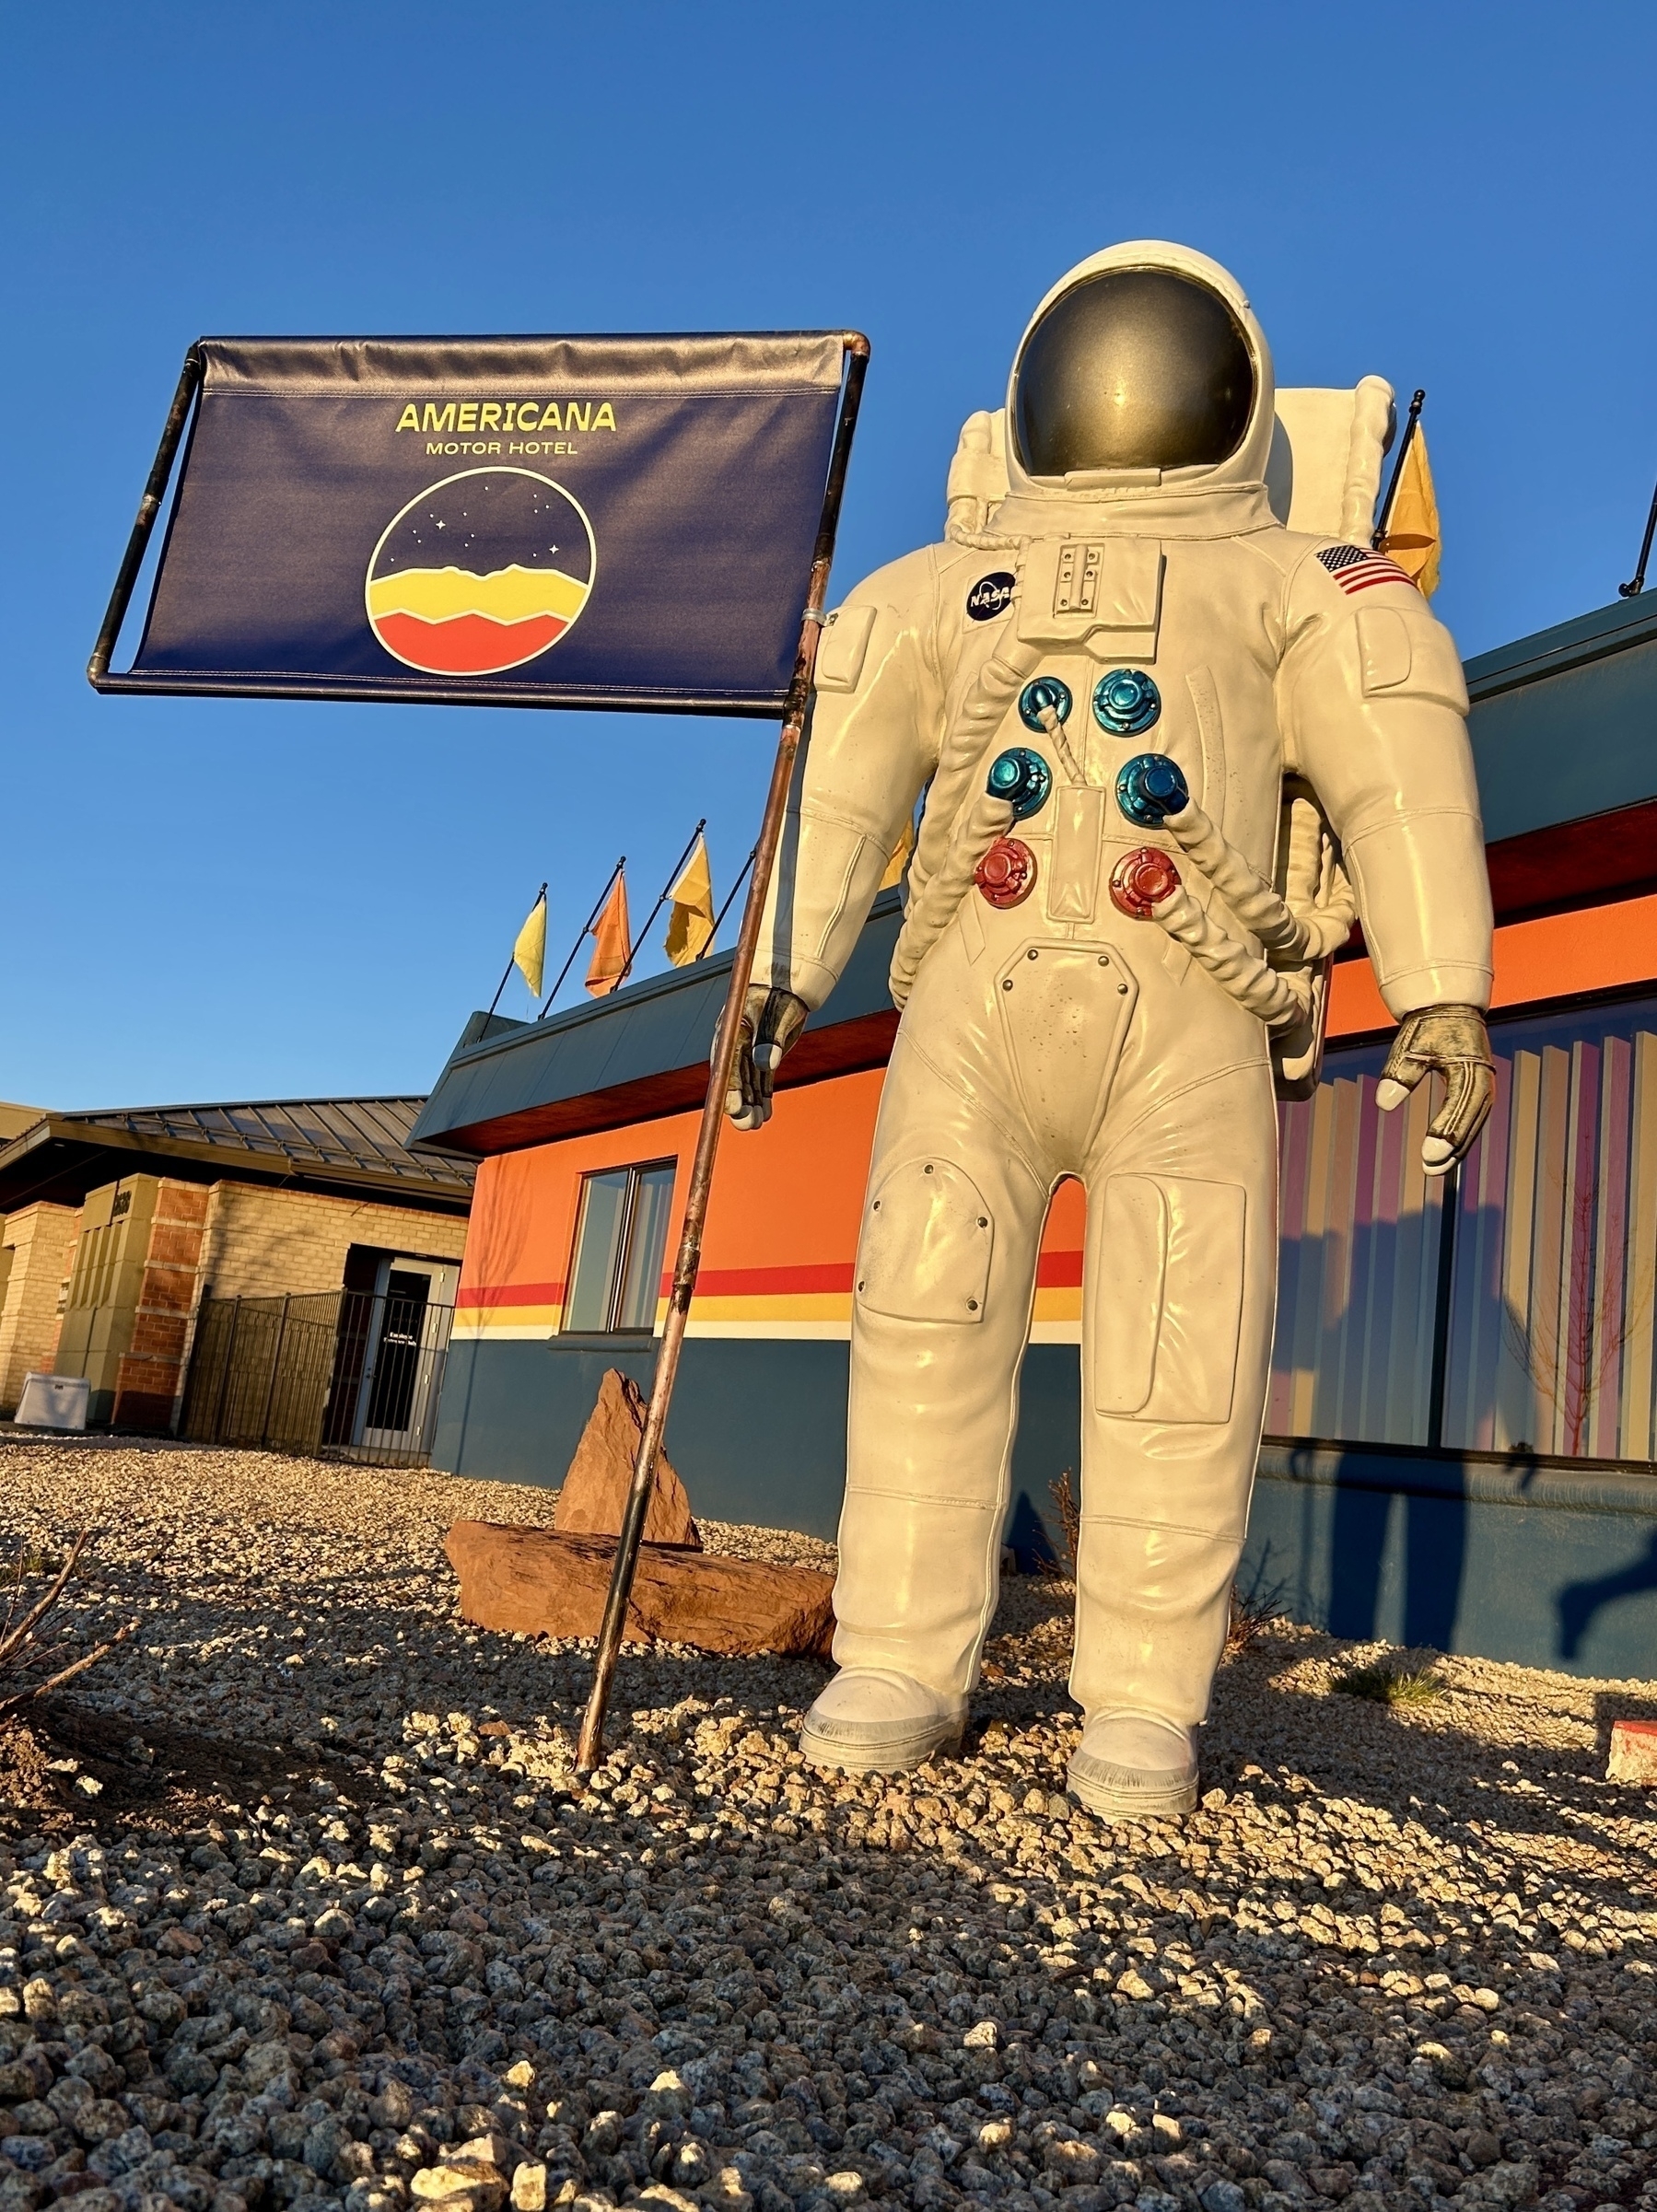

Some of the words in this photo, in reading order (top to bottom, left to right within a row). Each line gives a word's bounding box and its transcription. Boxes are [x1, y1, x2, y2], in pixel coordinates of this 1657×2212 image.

[395, 402, 617, 433] AMERICANA
[426, 441, 502, 455] MOTOR
[508, 441, 578, 455] HOTEL
[970, 586, 1010, 608] NASA
[390, 1332, 413, 1340] Employe
